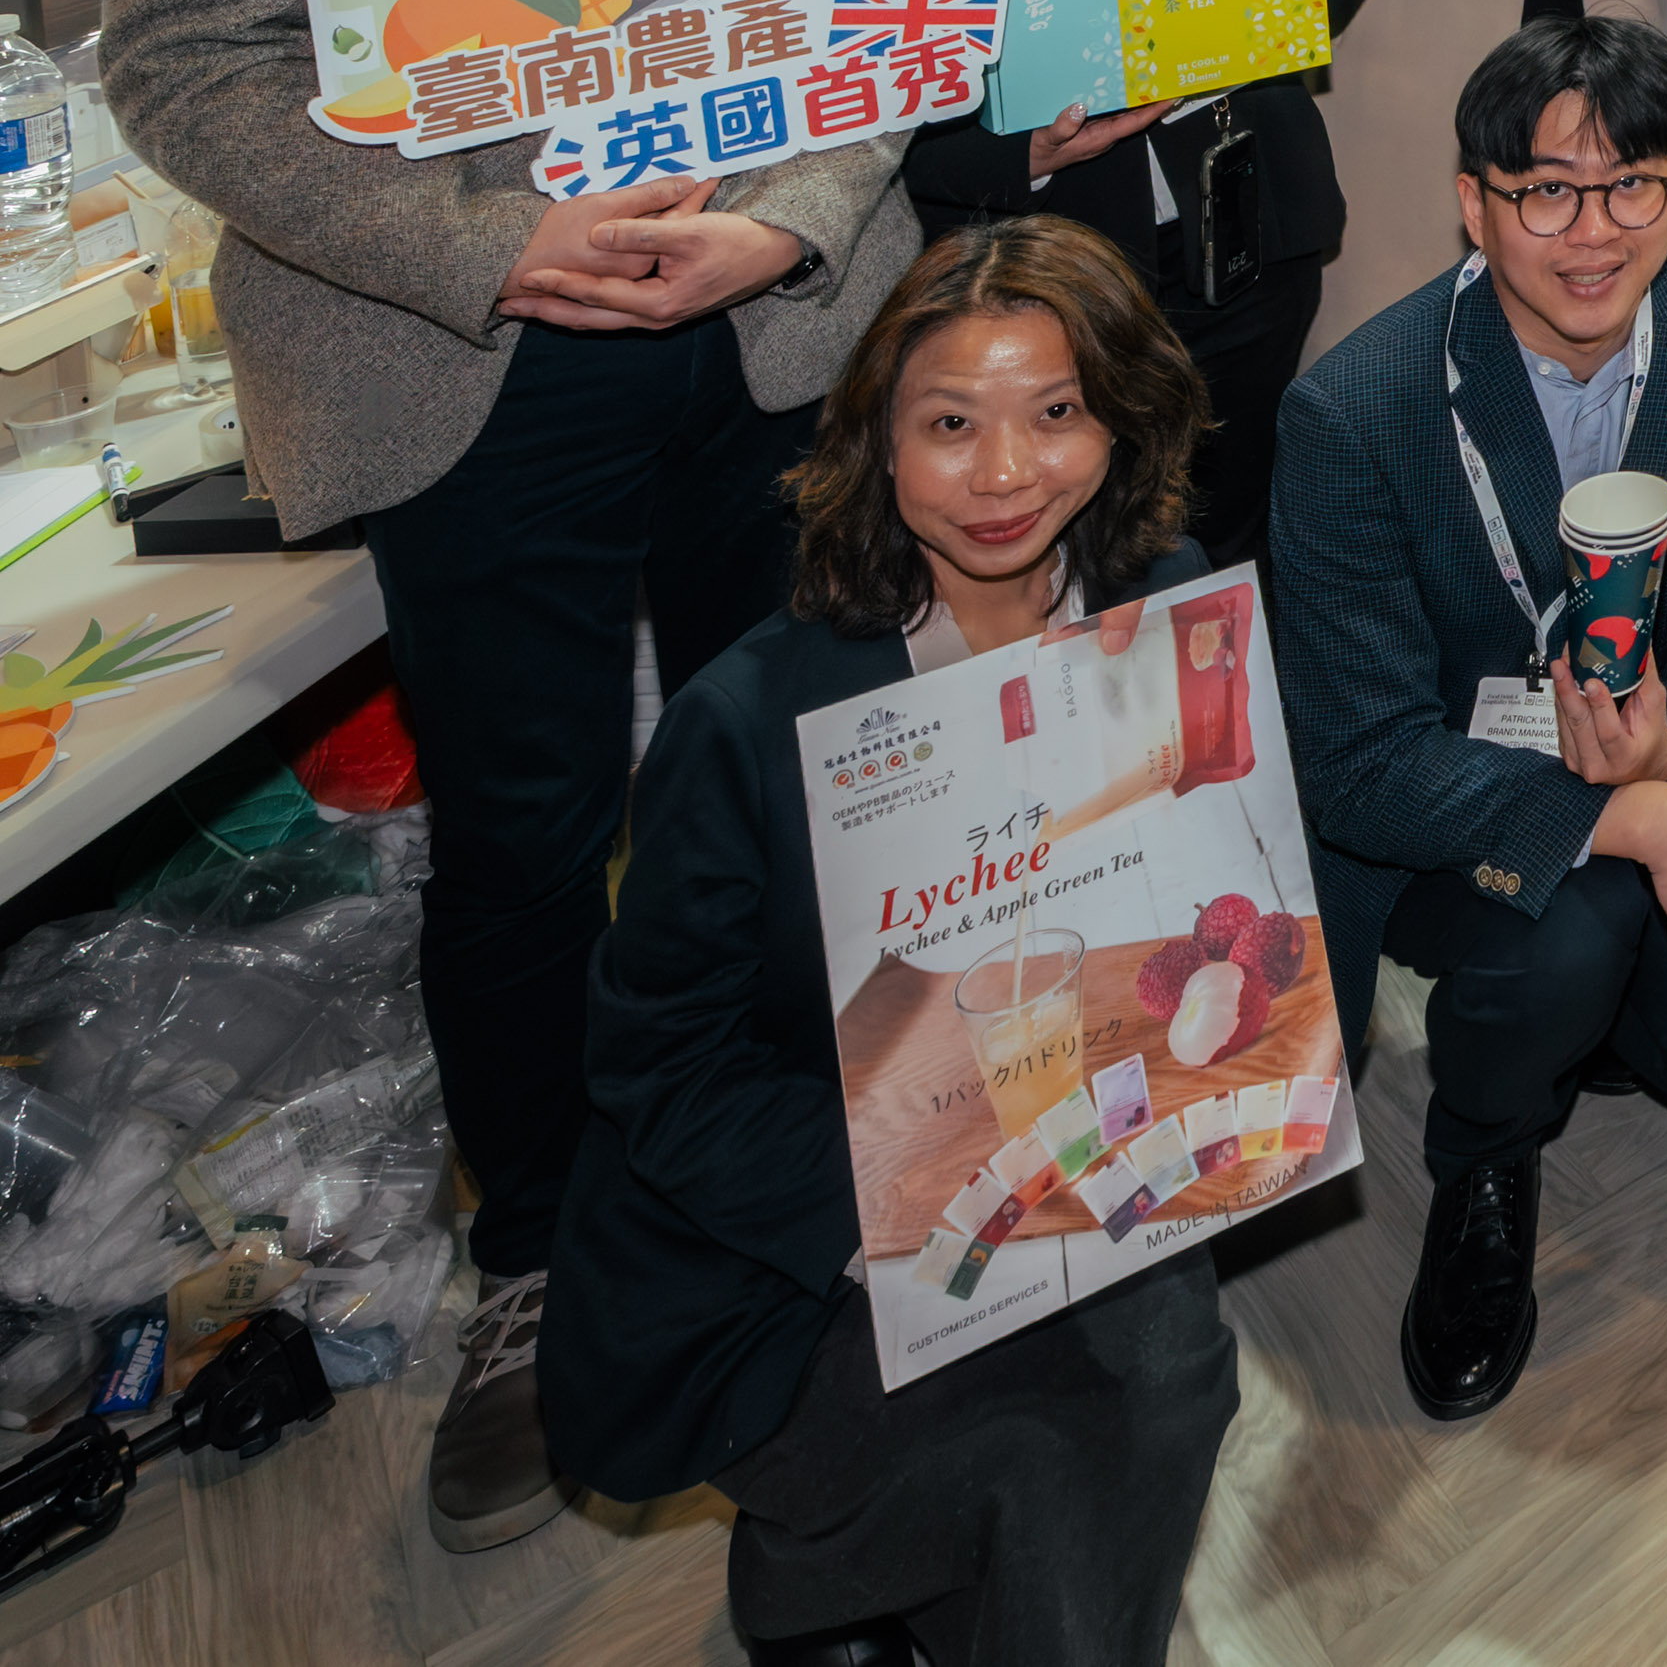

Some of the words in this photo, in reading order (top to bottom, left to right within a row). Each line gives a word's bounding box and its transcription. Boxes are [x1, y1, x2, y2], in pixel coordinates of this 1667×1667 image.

[597, 32, 972, 188] 英國首秀
[1060, 662, 1078, 718] BAGGO
[1501, 714, 1538, 725] PATRICK
[1539, 716, 1555, 725] WU
[1487, 727, 1517, 736] BRAND
[832, 769, 956, 822] OEMやPB製品のジュース
[965, 800, 1052, 851] ライチ
[875, 840, 1052, 936] Lychee
[877, 926, 953, 961] Lychee
[957, 911, 975, 934] &
[980, 891, 1039, 930] Apple
[1044, 866, 1105, 899] Green
[1110, 848, 1145, 874] Tea
[1145, 1213, 1207, 1250] MADE
[1210, 1197, 1230, 1223] IN
[1231, 1158, 1312, 1209] TAIWAN
[906, 1301, 988, 1354] CUSTOMIZED
[988, 1279, 1050, 1319] SERVICES
